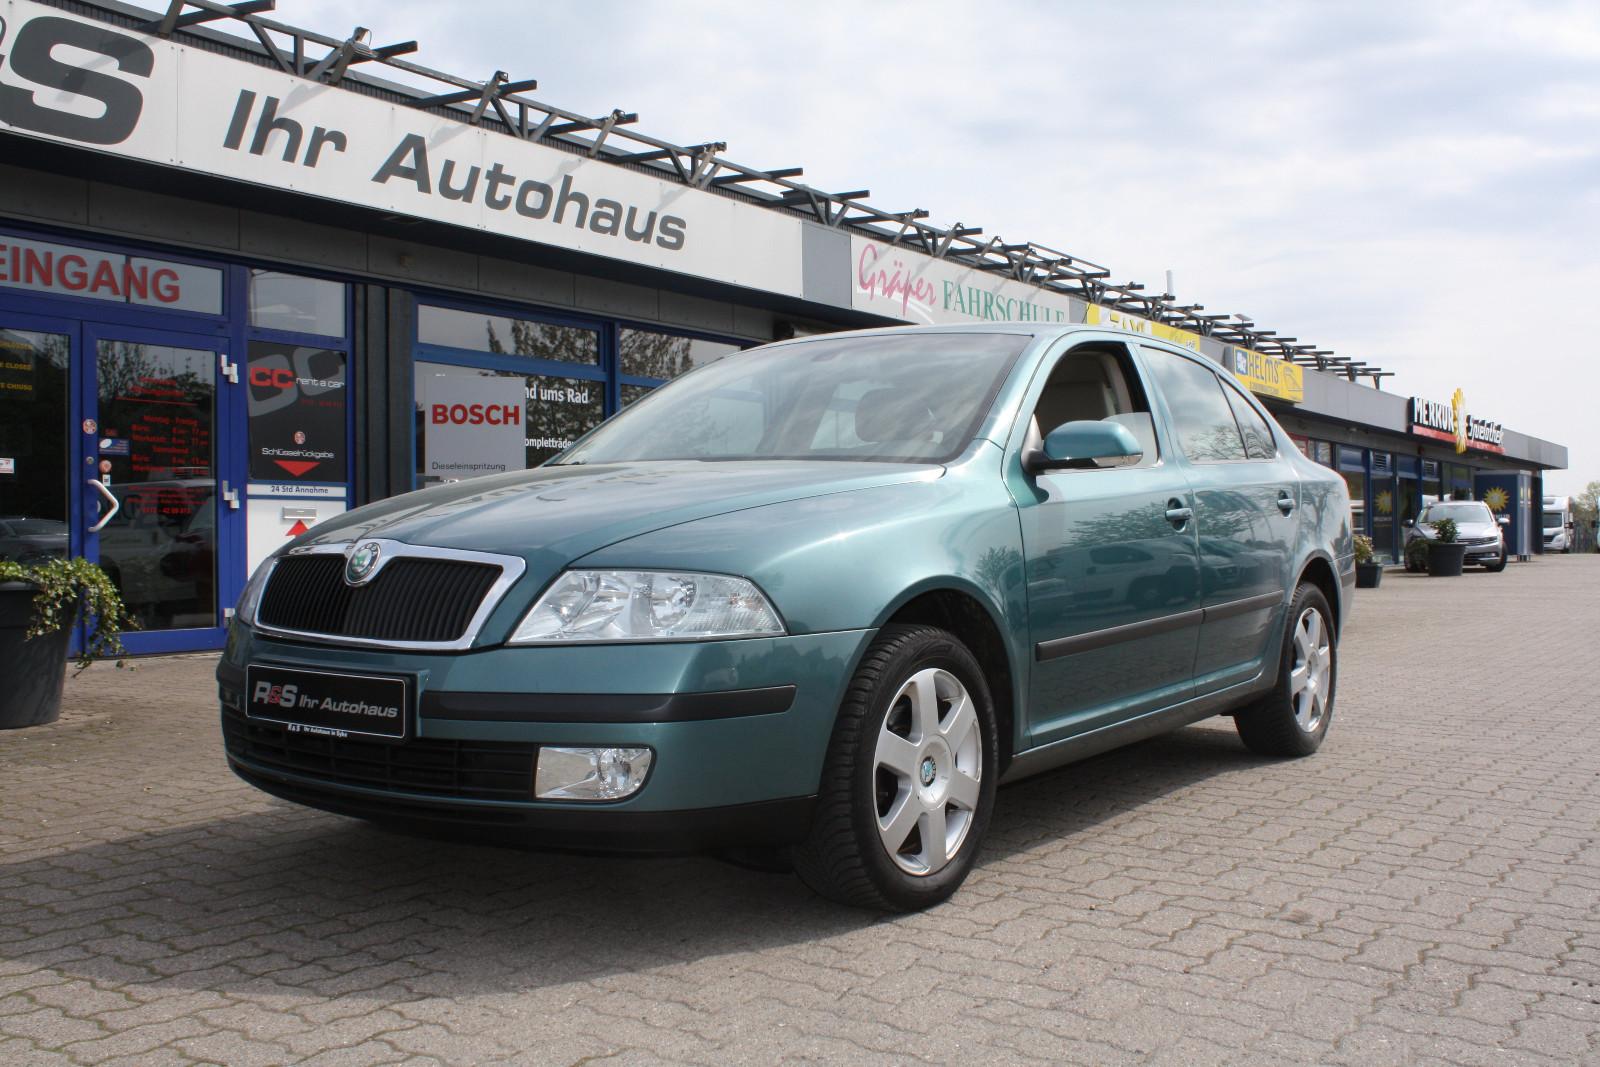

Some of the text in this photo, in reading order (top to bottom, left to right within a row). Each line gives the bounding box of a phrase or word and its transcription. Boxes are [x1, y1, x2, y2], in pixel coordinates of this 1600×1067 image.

[0, 15, 687, 252] S Ihr Autohaus
[858, 243, 937, 316] Gräper
[250, 366, 295, 390] CC
[540, 388, 564, 402] ums
[567, 388, 589, 404] Rad
[431, 403, 520, 426] BOSCH
[1413, 397, 1454, 432] MERKUR
[524, 436, 574, 450] ompletträde
[431, 461, 506, 472] Dieseleinspritzung
[271, 485, 329, 495] 24 Std Annahme
[253, 680, 398, 718] R&S Ihr Autohaus
